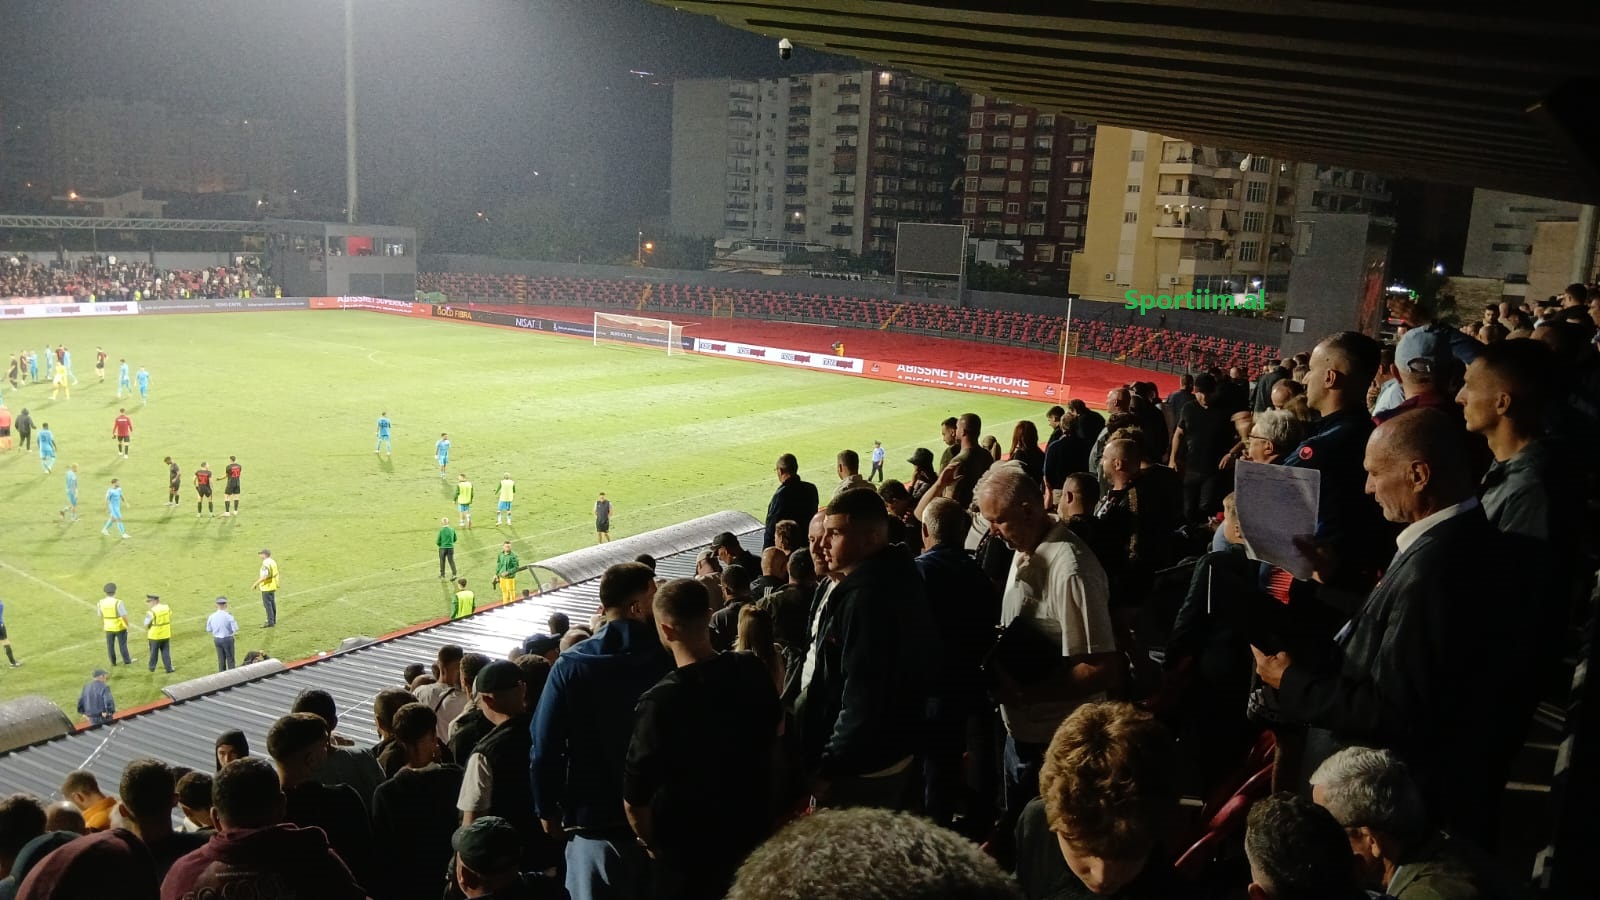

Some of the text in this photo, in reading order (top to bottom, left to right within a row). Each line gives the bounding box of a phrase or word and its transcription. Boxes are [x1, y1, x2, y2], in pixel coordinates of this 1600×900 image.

[454, 310, 473, 320] FIBRA
[896, 364, 953, 379] ABISSNET
[957, 371, 1030, 388] SUPERIORE
